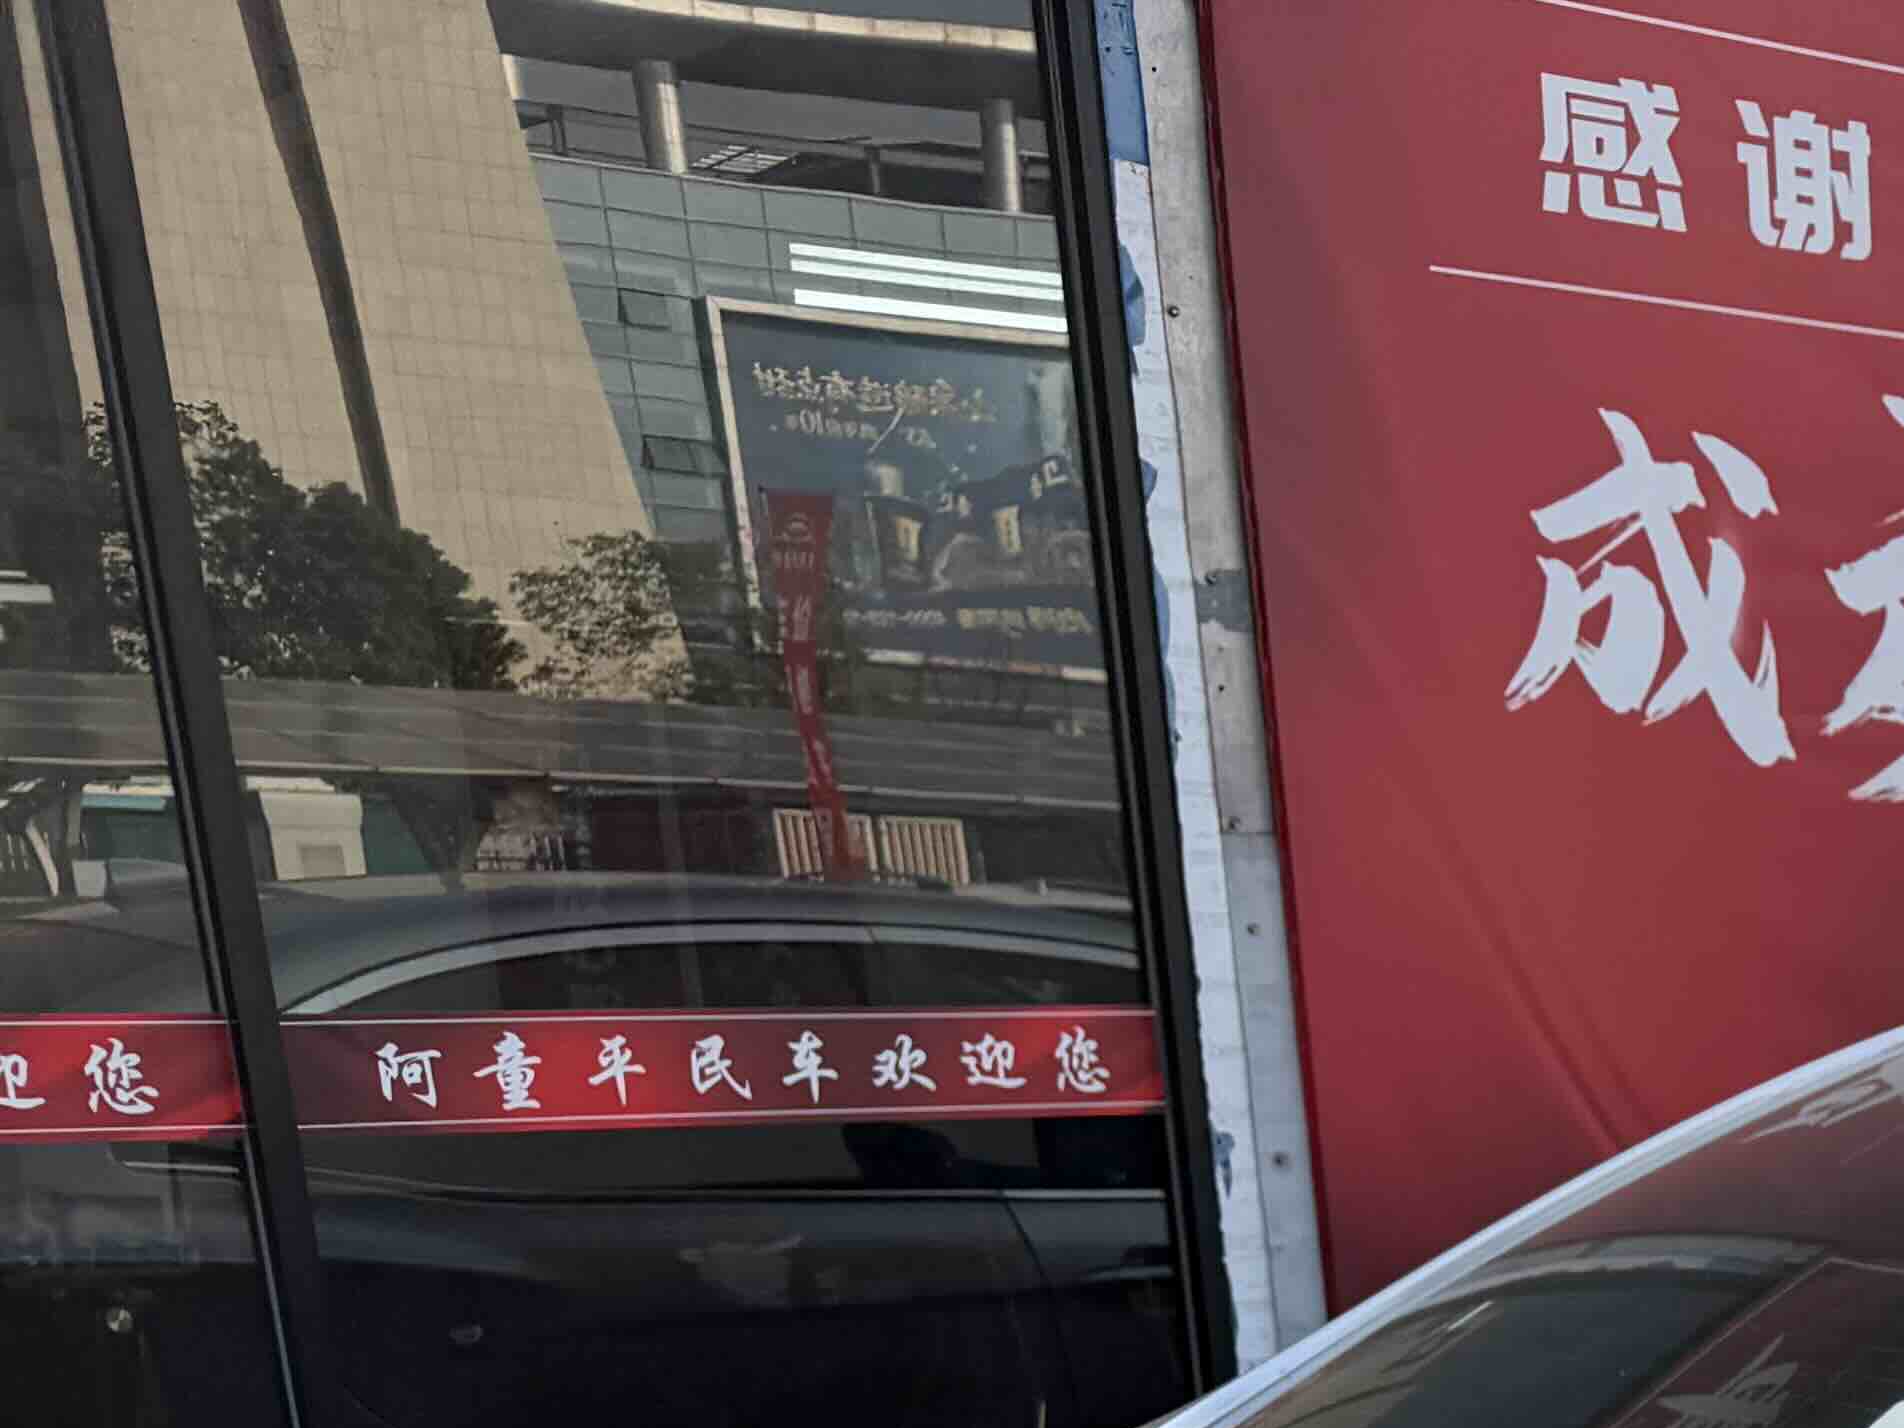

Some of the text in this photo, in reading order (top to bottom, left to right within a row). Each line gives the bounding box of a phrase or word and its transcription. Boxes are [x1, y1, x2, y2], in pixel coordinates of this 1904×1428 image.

[376, 1026, 1112, 1111] 阿童平民车欢迎您
